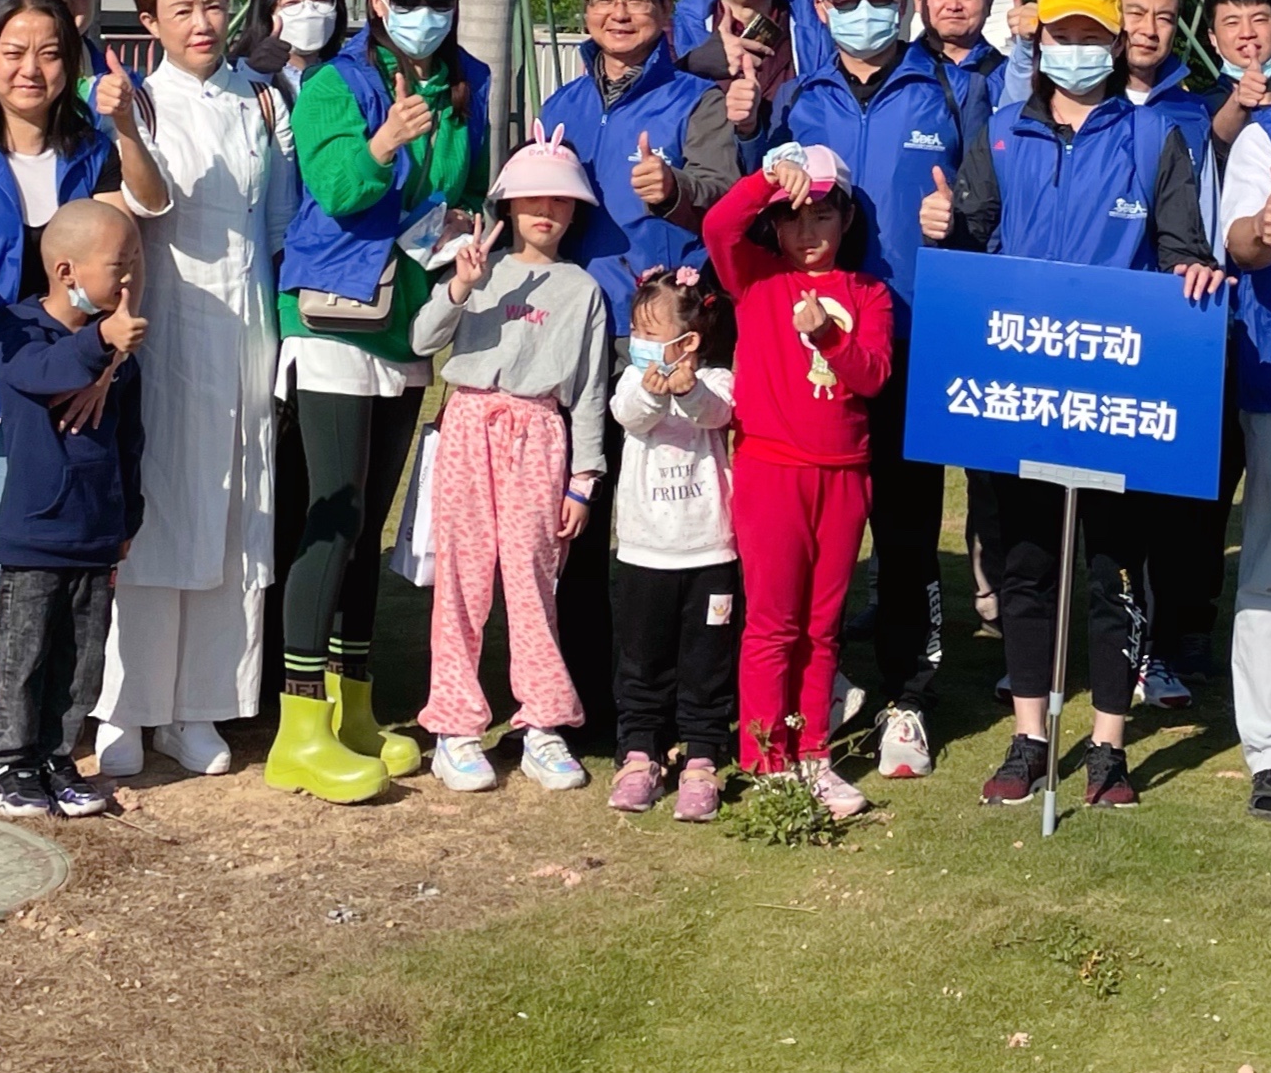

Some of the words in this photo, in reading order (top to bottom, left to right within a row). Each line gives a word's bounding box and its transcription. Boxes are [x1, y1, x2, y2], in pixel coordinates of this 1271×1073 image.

[986, 310, 1143, 366] 坝光行动
[945, 377, 1178, 442] 公益环保活动
[652, 480, 706, 502] FRIDAY
[659, 463, 696, 479] WITH
[927, 580, 942, 626] KEEP
